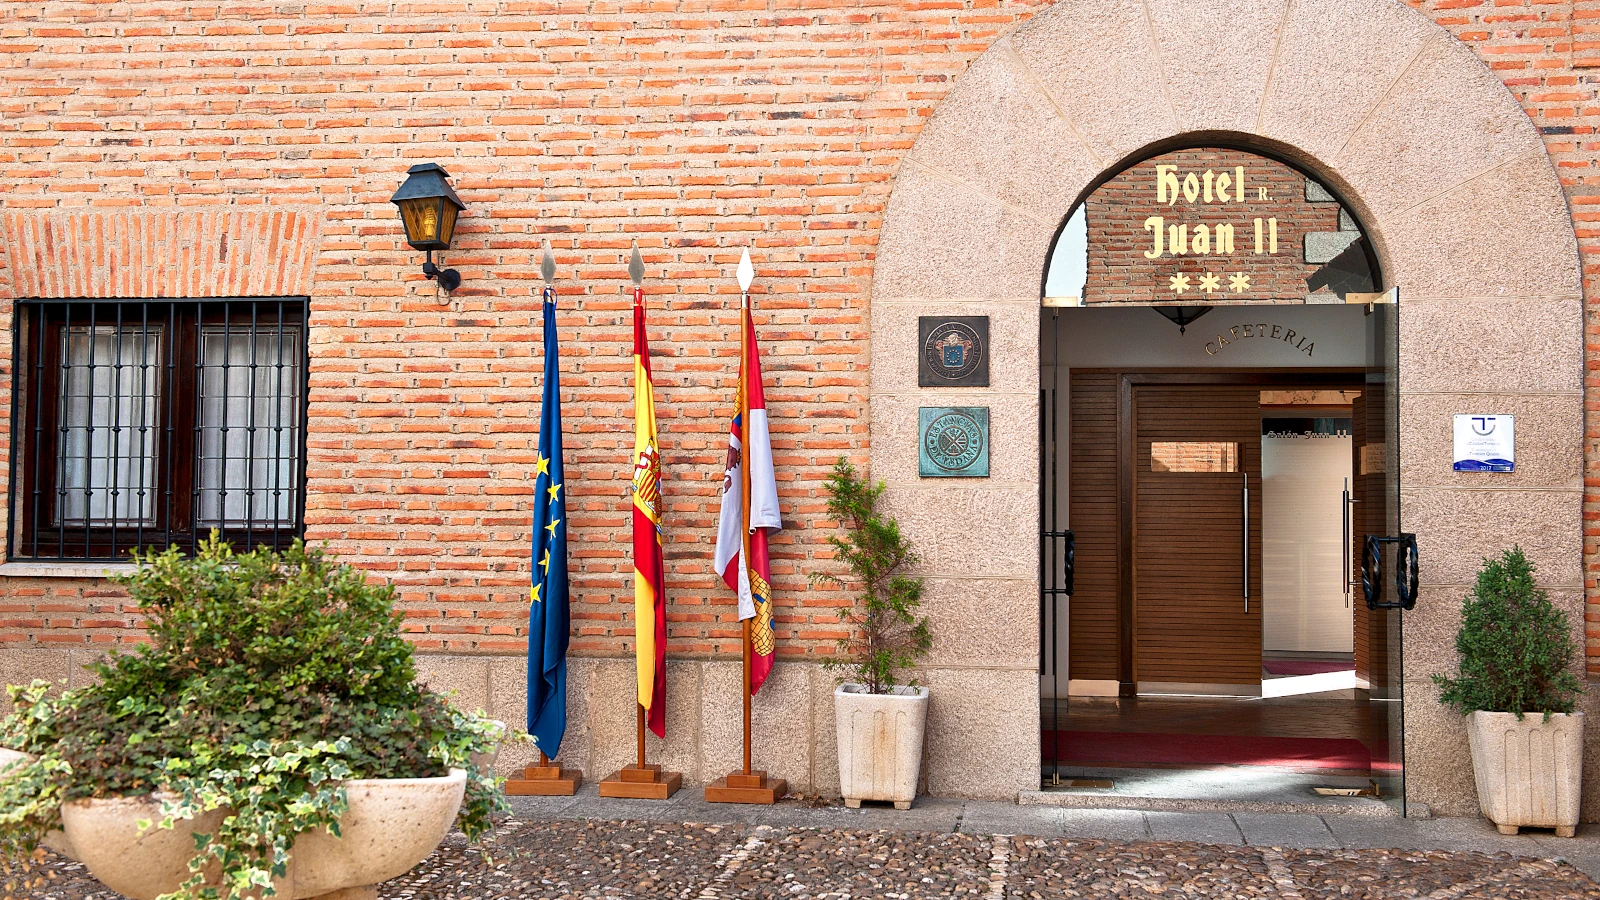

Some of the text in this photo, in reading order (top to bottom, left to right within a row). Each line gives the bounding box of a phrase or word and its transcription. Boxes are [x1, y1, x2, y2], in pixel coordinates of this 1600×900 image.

[1156, 165, 1245, 206] Hotel
[1144, 216, 1235, 259] Juan
[1204, 323, 1315, 357] CAFETERIA
[929, 416, 978, 439] ESTANCIAS
[1304, 430, 1330, 440] Juan
